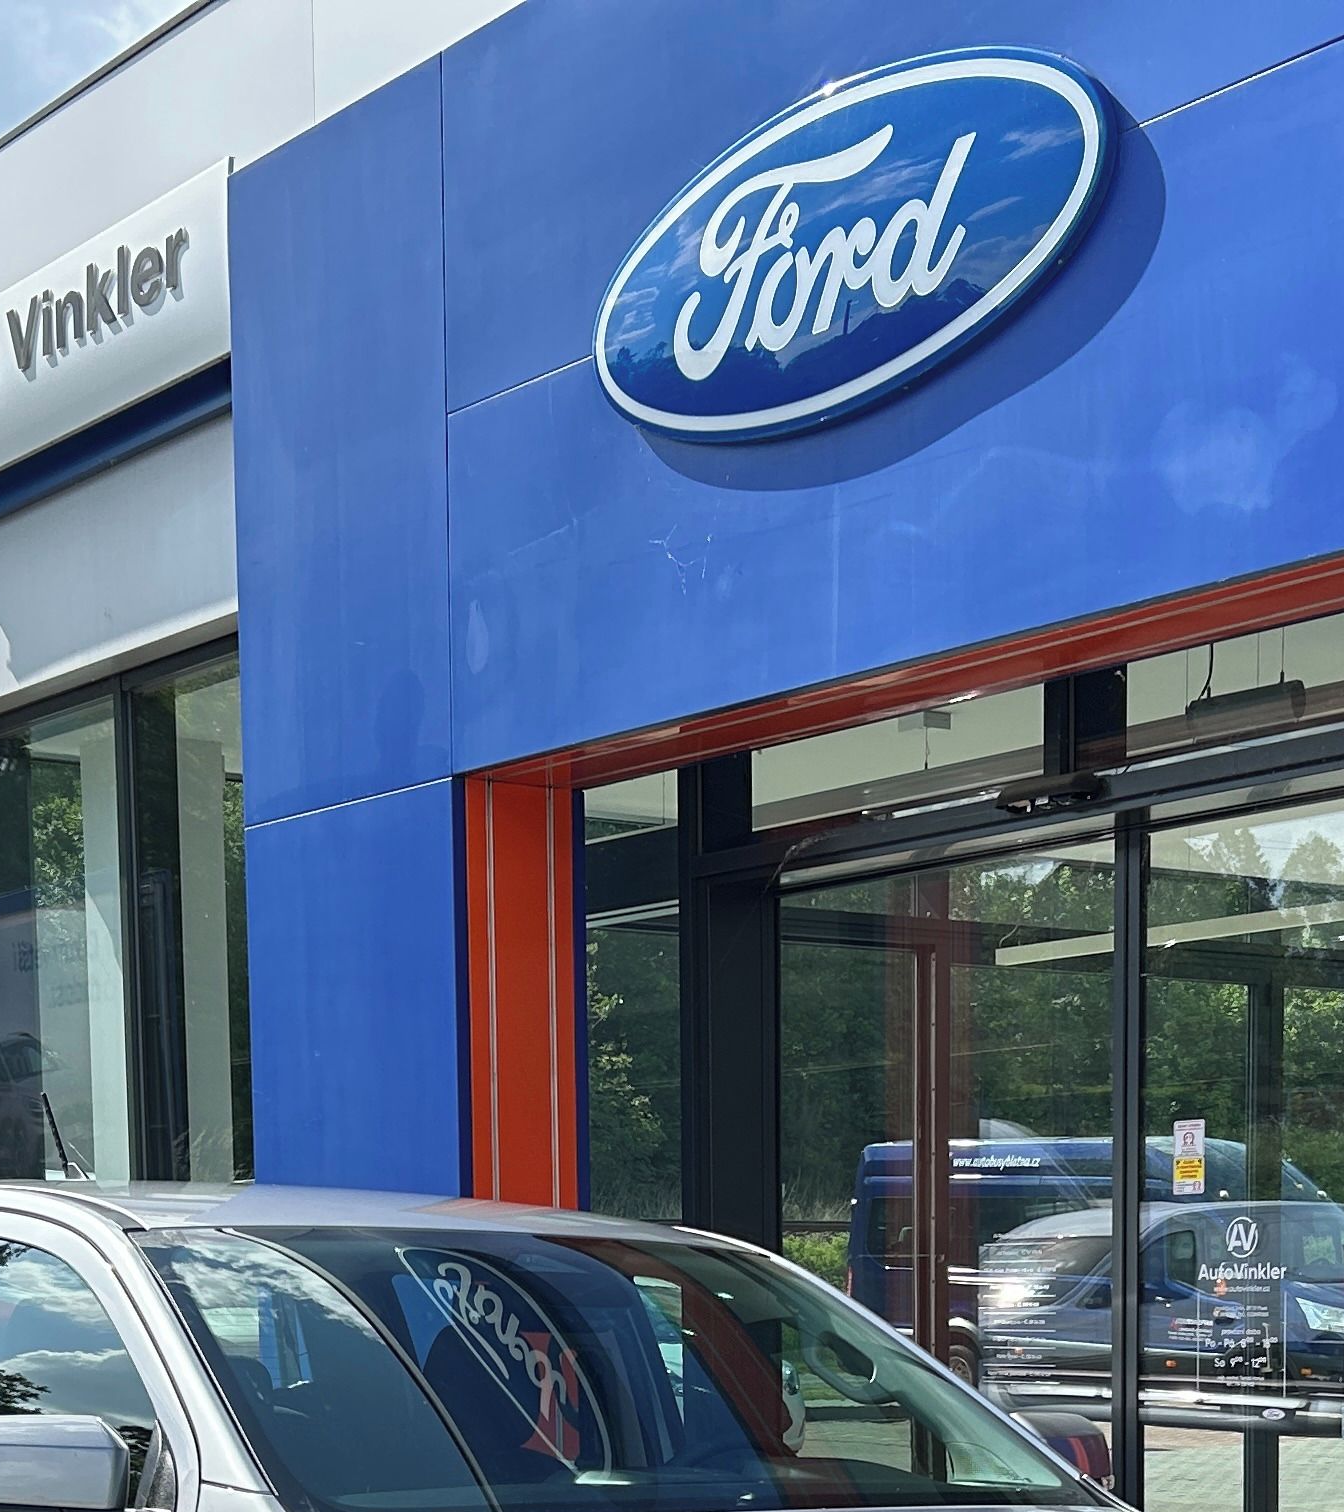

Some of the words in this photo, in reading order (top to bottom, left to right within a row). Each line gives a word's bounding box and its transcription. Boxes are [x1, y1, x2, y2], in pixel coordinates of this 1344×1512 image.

[6, 226, 190, 374] Vinkler
[673, 123, 977, 381] Ford
[1197, 1262, 1288, 1281] AutoVinkler
